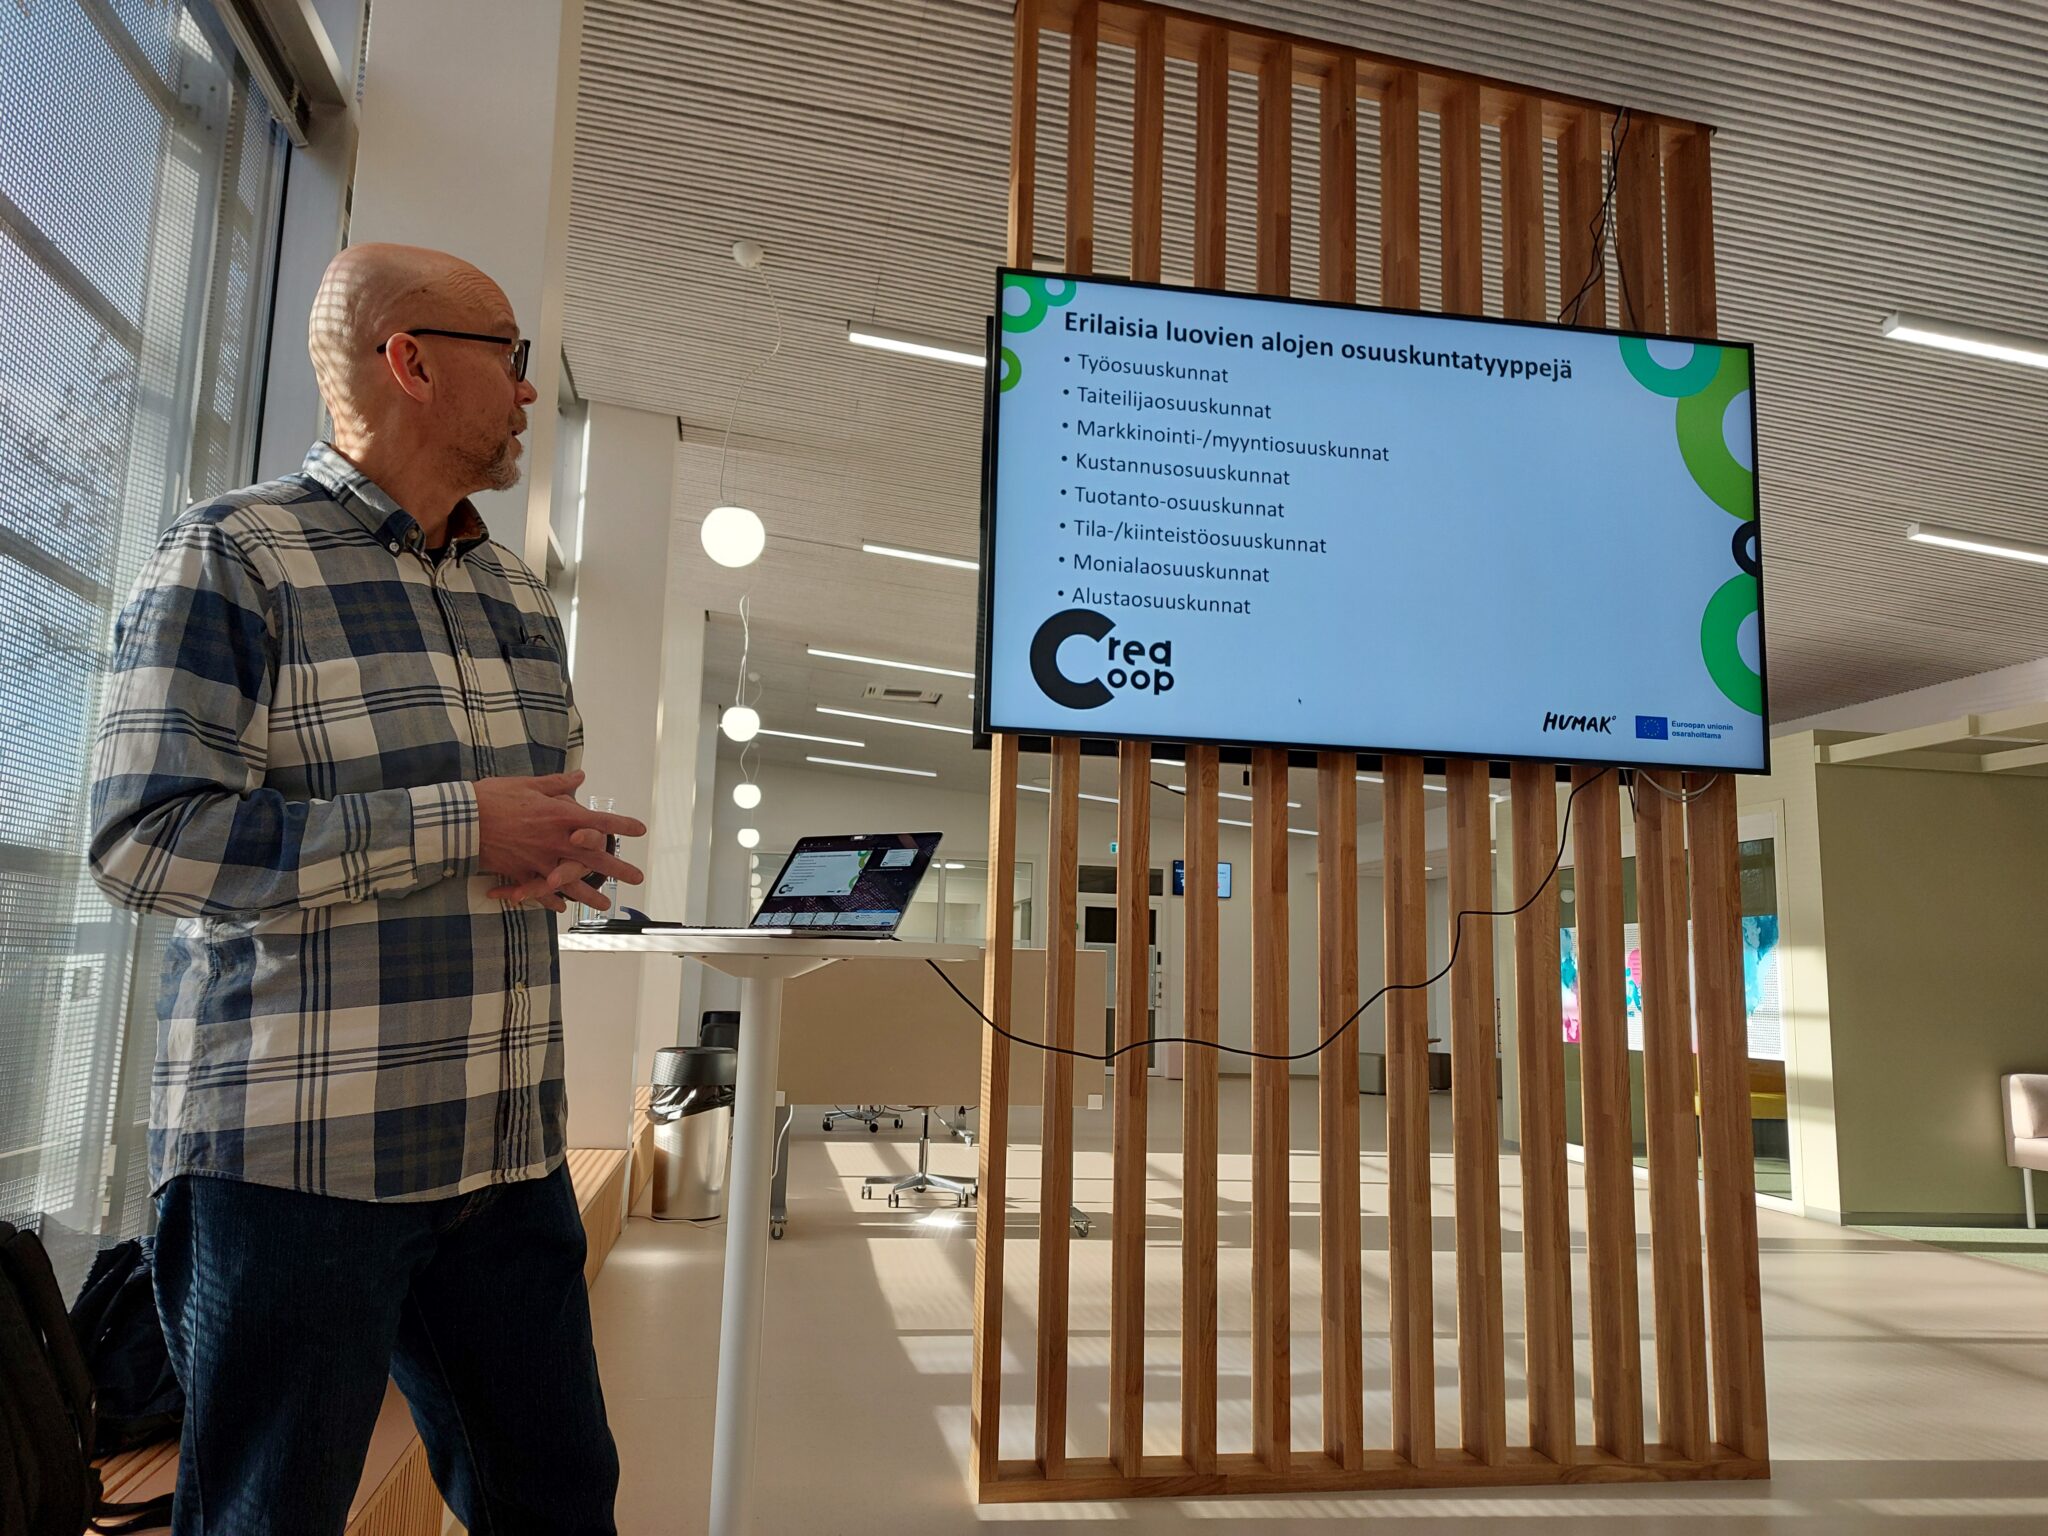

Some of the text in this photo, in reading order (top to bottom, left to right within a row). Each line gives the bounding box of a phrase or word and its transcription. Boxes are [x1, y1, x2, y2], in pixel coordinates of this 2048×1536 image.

[1065, 311, 1572, 382] Erilaisia luovien alojen osuuskuntatyyppejä
[1078, 353, 1229, 383] Työosuuskunnat
[1077, 386, 1271, 419] Taiteilijaosuuskunnat
[1077, 420, 1389, 462] Markkinointi-/myyntiosuuskunnat
[1076, 453, 1290, 486] Kustannusosuuskunnat
[1075, 486, 1285, 518] Tuotanto-osuuskunnat
[1074, 520, 1327, 554] Tila-/kiinteistöosuuskunnat
[1073, 554, 1270, 583] Monialaosuuskunnat
[1072, 587, 1251, 615] Alustaosuuskunnat
[1671, 720, 1734, 731] Euroopan unionin
[1671, 731, 1722, 740] osarahoittama
